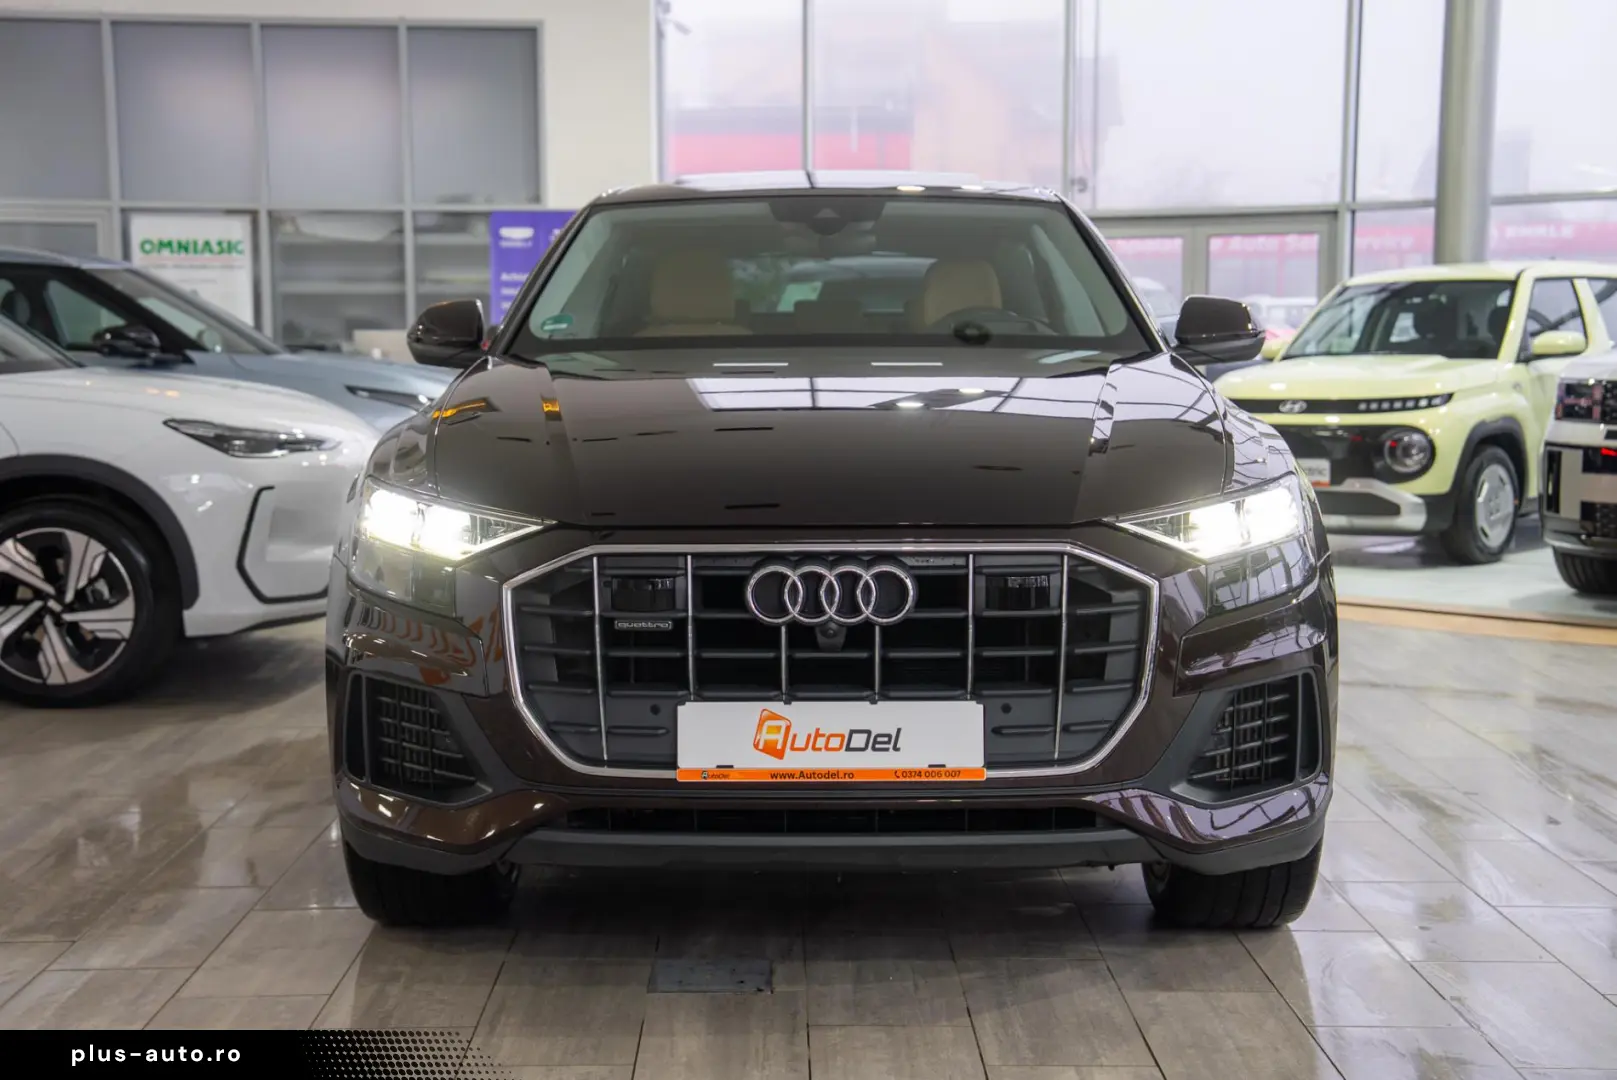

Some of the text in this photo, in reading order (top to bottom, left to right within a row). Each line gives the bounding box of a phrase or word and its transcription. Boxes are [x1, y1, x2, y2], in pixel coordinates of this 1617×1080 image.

[754, 713, 902, 757] AutoDel
[770, 770, 855, 780] www.Autodel.ro
[901, 770, 922, 778] 0374
[924, 770, 942, 778] 006
[944, 770, 961, 778] 007
